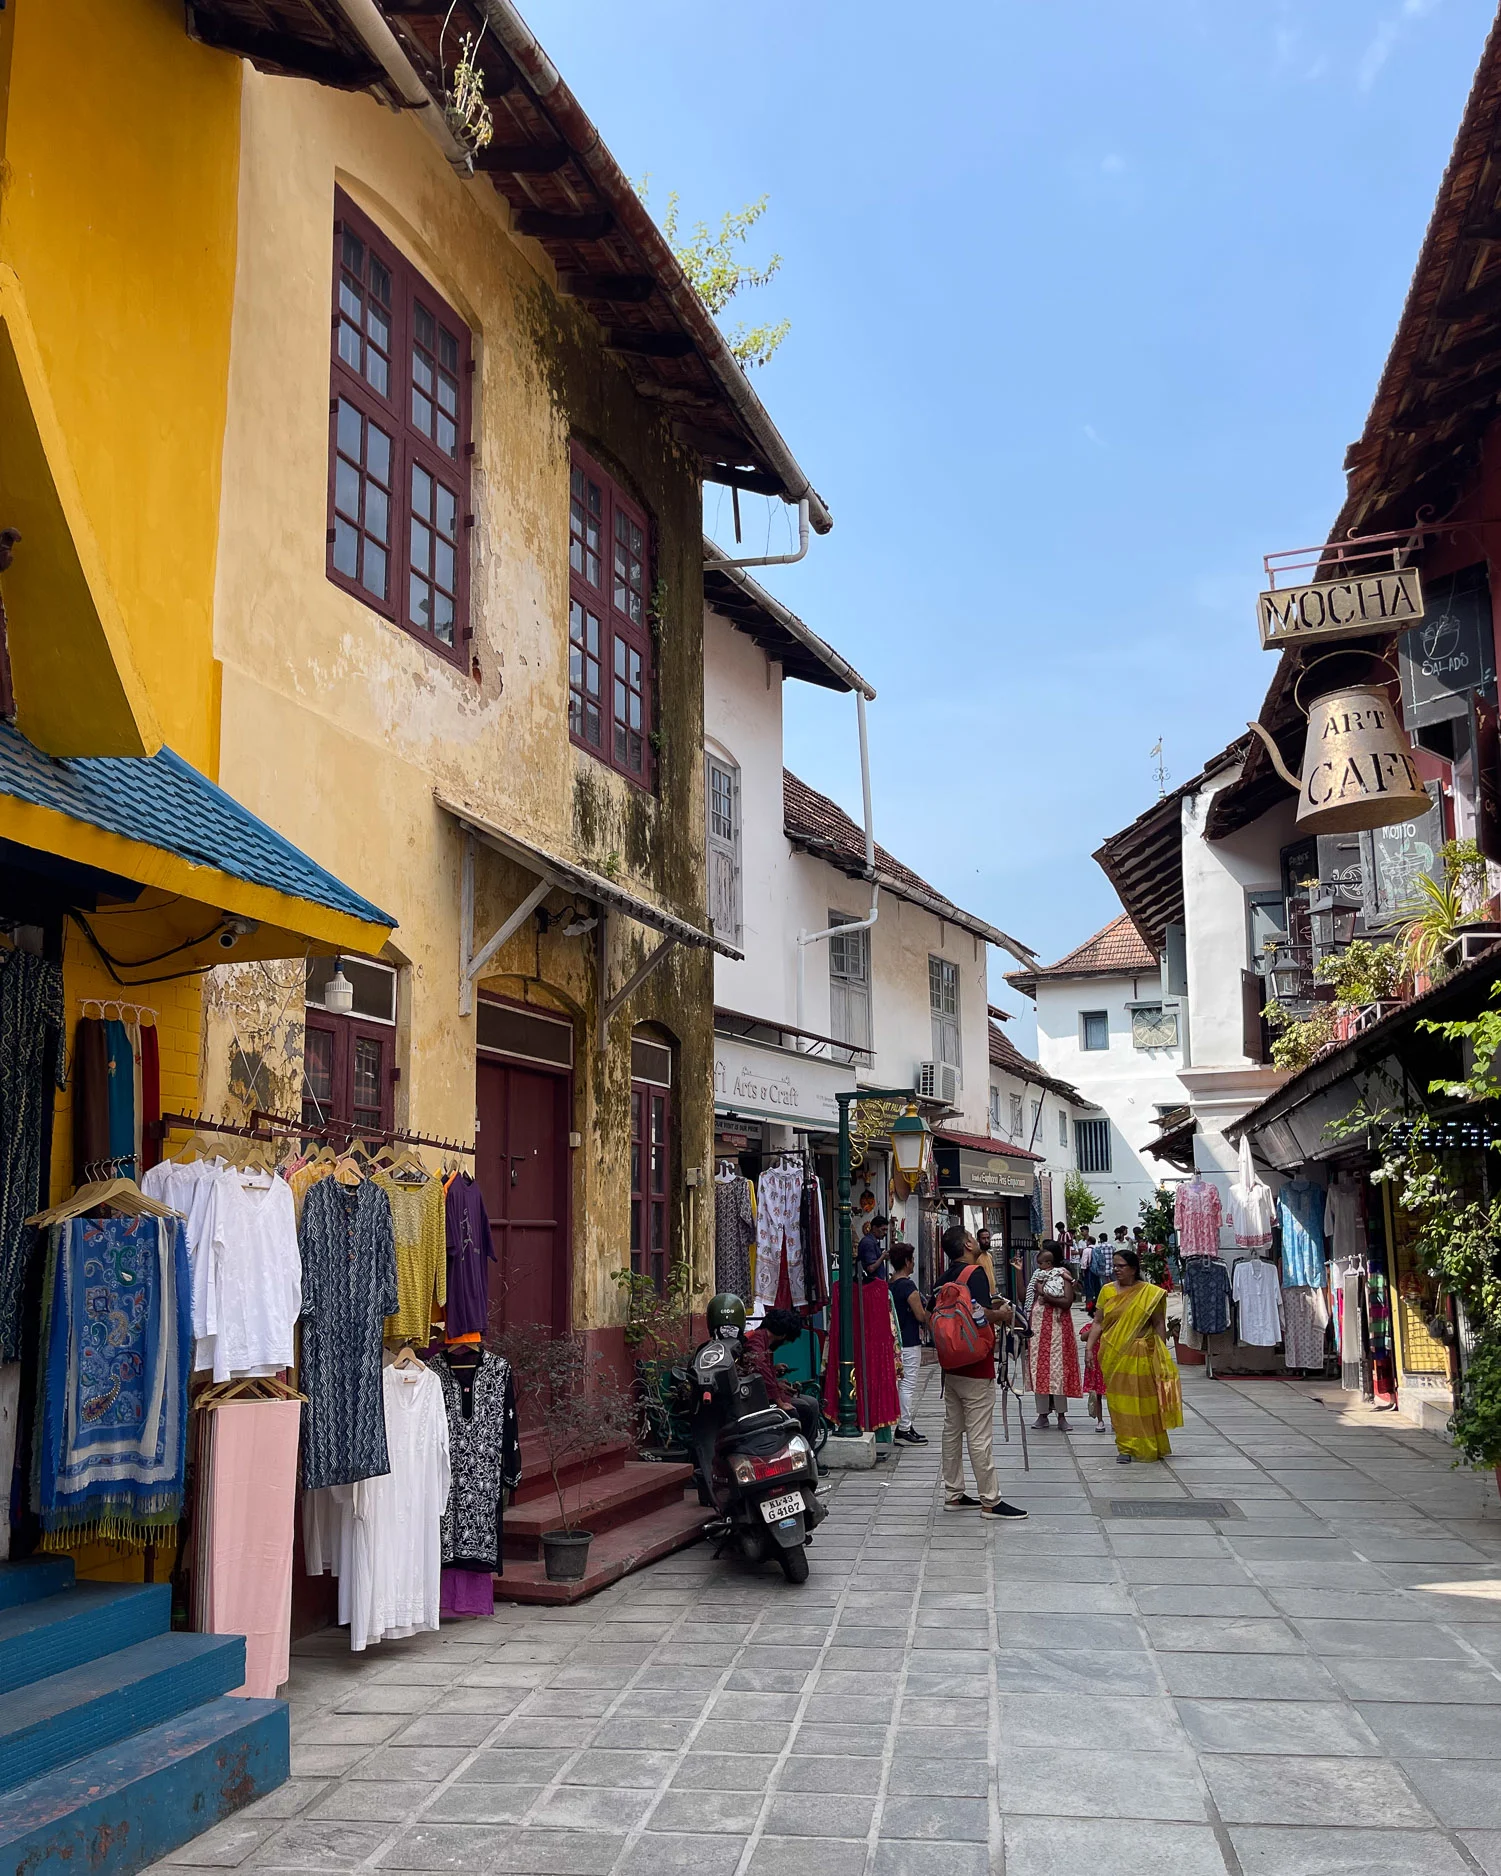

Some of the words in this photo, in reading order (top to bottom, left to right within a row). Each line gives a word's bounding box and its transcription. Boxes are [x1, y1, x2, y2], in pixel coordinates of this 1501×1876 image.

[1263, 577, 1418, 635] MOCHA
[1421, 653, 1469, 676] SALADS
[1322, 710, 1386, 739] ART
[1307, 753, 1427, 806] CAFE
[1382, 823, 1416, 839] MOJITO
[714, 1060, 726, 1094] fi
[733, 1076, 757, 1100] Arts
[769, 1084, 799, 1107] Craft
[768, 1510, 776, 1520] G
[777, 1502, 800, 1517] 4187
